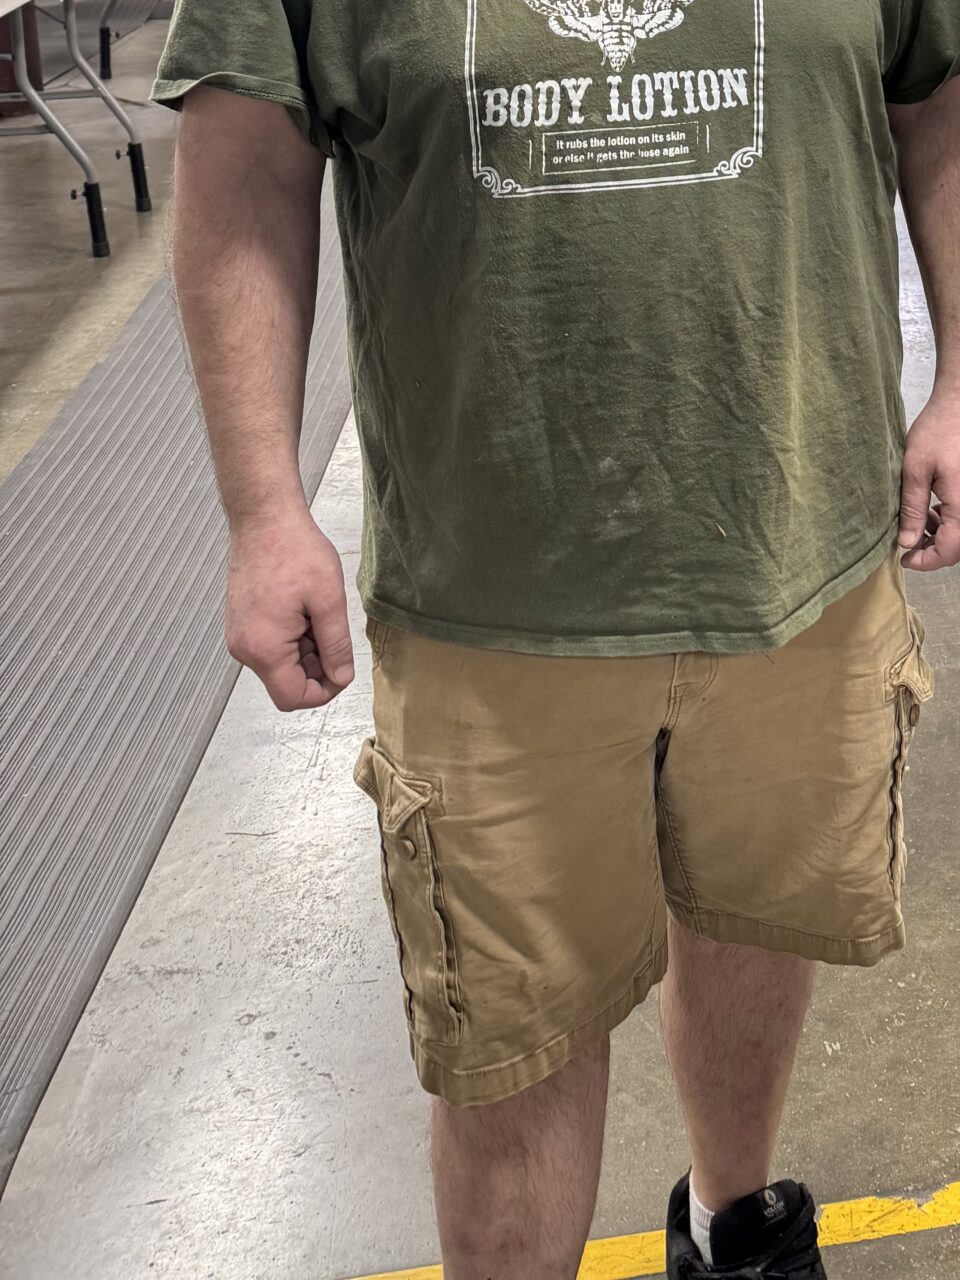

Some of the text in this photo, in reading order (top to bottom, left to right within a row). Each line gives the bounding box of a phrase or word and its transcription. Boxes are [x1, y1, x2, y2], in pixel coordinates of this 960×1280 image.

[481, 68, 750, 128] BODY LOTION
[566, 138, 589, 149] rubs
[590, 137, 606, 148] the
[607, 135, 636, 146] lotion
[637, 136, 650, 145] on
[665, 131, 686, 142] skin
[552, 155, 563, 165] or
[564, 151, 585, 164] else
[596, 150, 618, 163] gets
[662, 144, 690, 157] again
